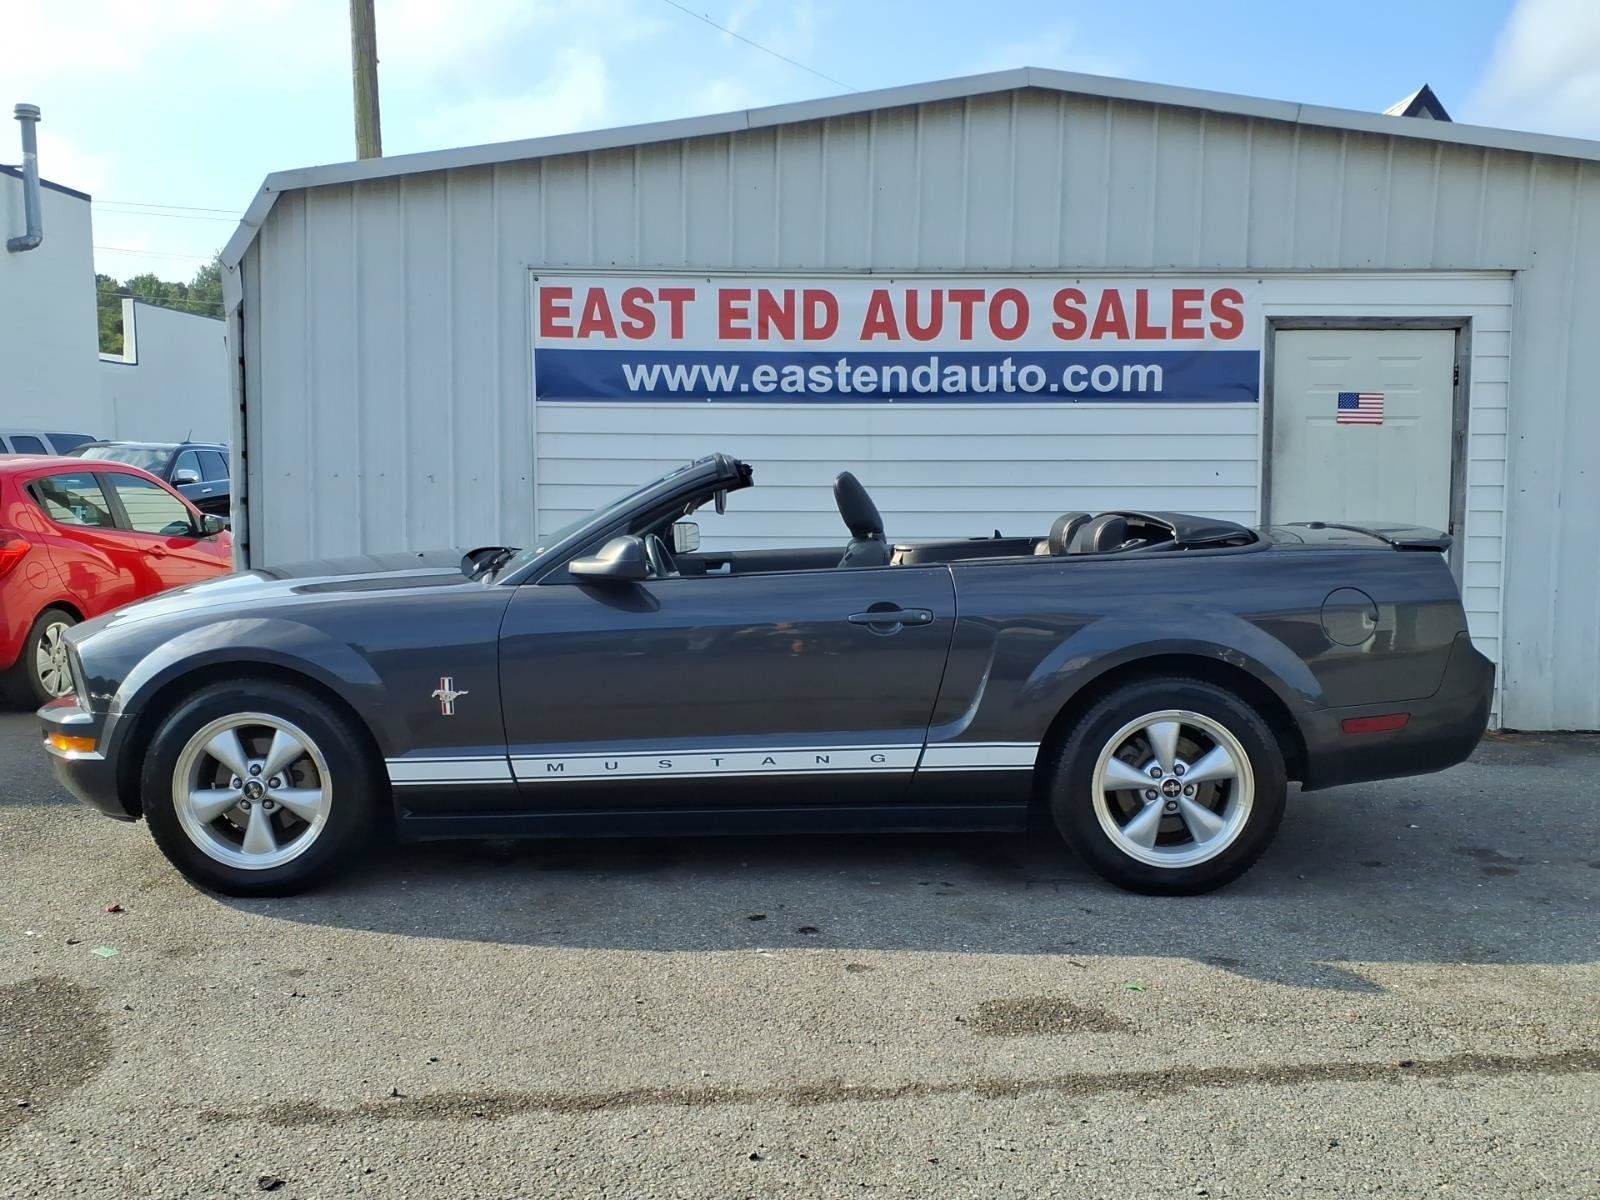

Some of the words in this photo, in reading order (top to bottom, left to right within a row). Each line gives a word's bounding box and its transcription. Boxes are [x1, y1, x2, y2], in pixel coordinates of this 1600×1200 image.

[538, 287, 695, 338] EAST
[718, 288, 839, 341] END
[859, 288, 1030, 341] AUTO
[1052, 288, 1245, 341] SALES
[622, 355, 1163, 395] www.eastendauto.com
[546, 753, 887, 773] MUSTANG
